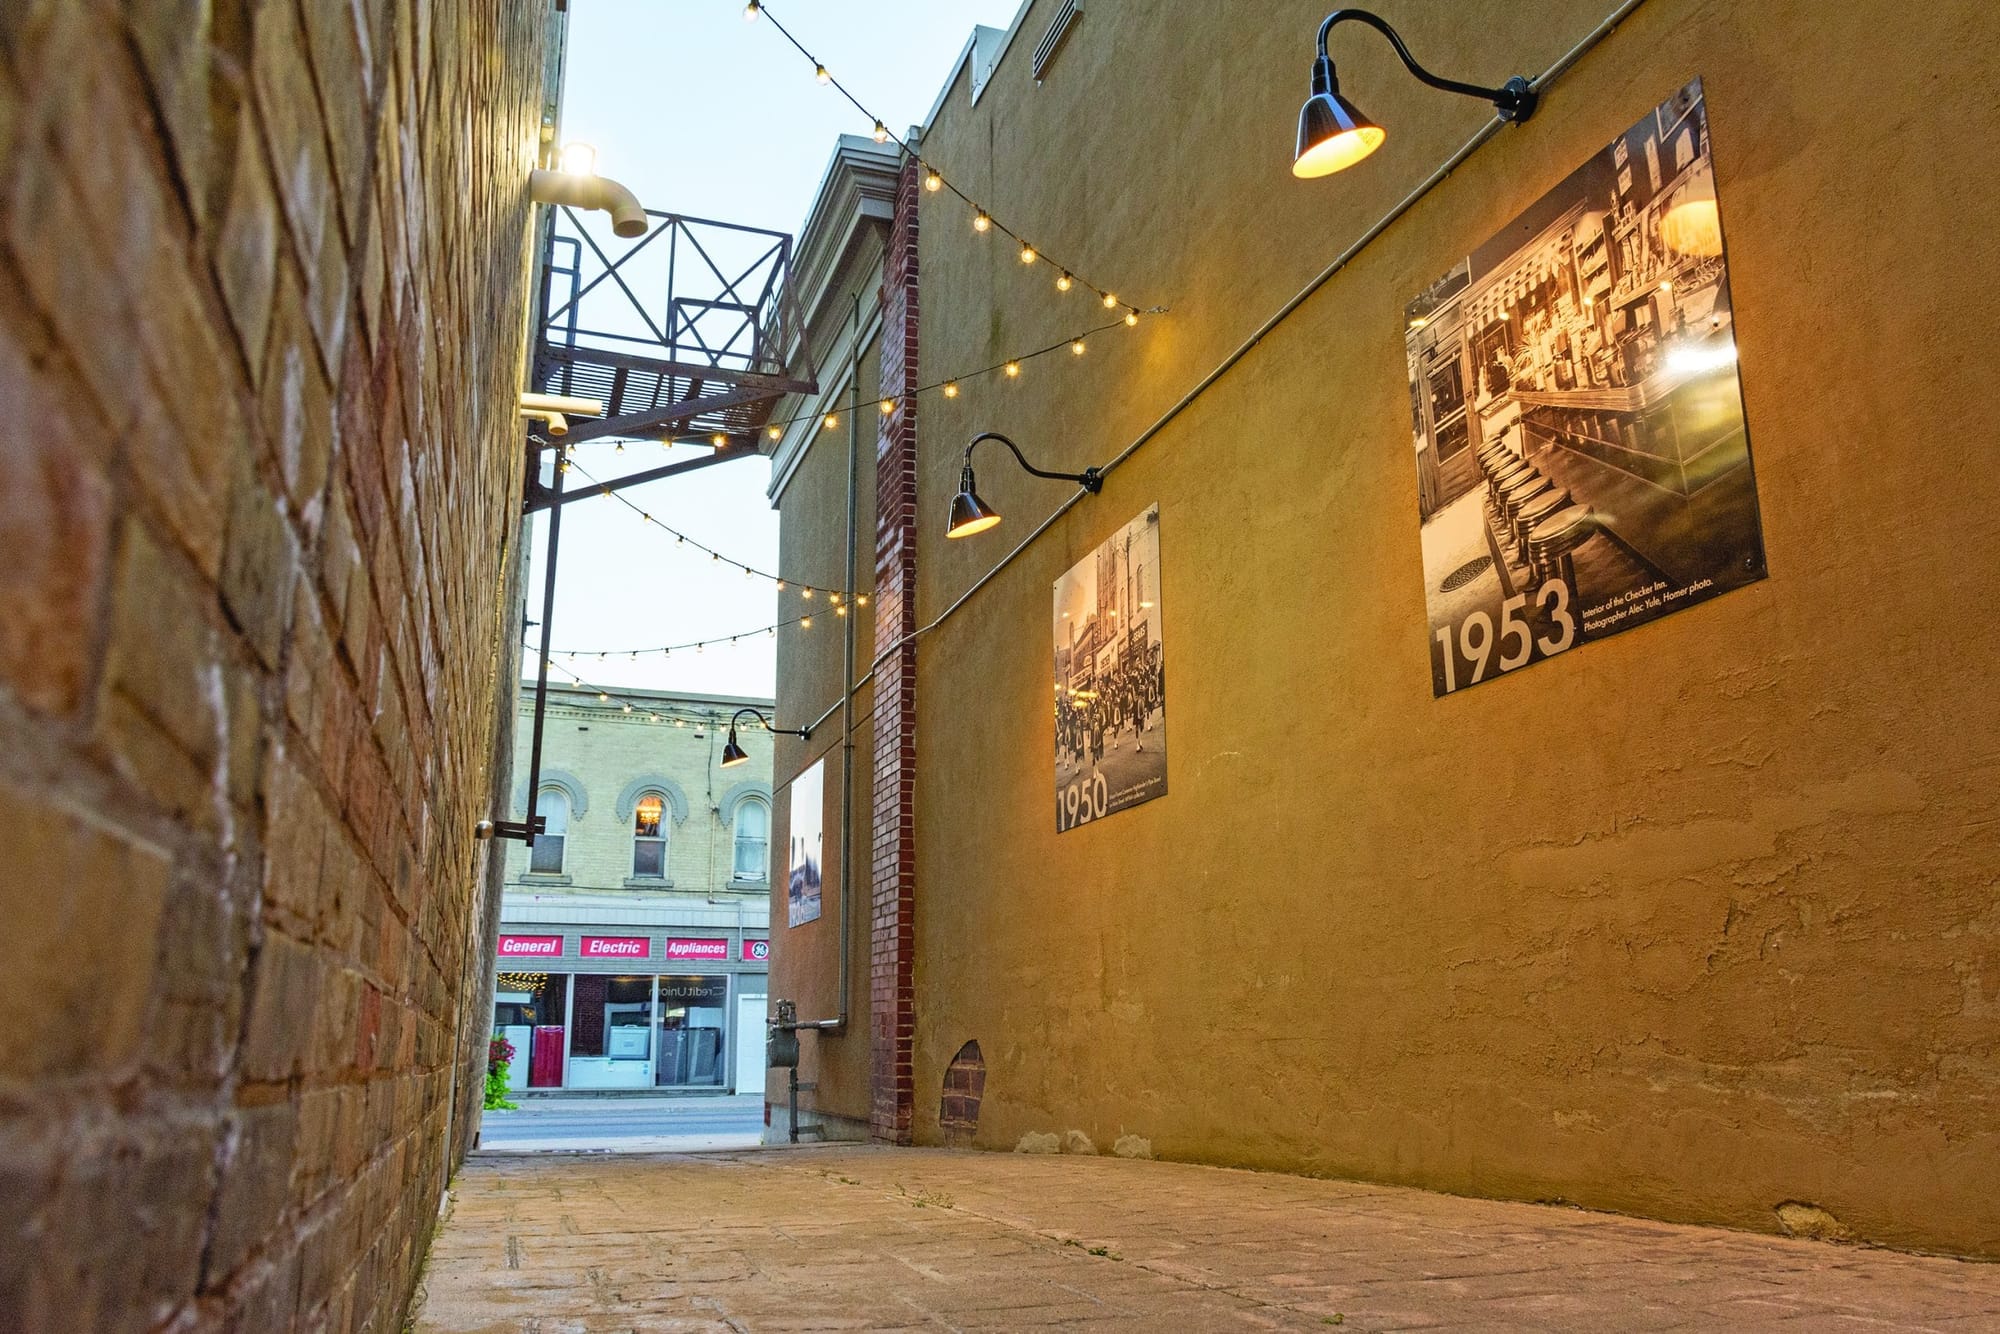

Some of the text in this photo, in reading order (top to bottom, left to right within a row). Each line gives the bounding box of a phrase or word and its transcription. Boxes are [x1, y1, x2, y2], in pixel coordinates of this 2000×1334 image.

[1582, 580, 1668, 618] Interior of the Checker Inn.
[1584, 610, 1627, 632] Photographer
[1628, 605, 1644, 615] Alec
[1645, 598, 1662, 610] Yule,
[1689, 578, 1713, 596] photo.
[1436, 578, 1574, 693] 1953
[1058, 772, 1108, 831] 1950
[503, 939, 725, 955] General Electric Appliances
